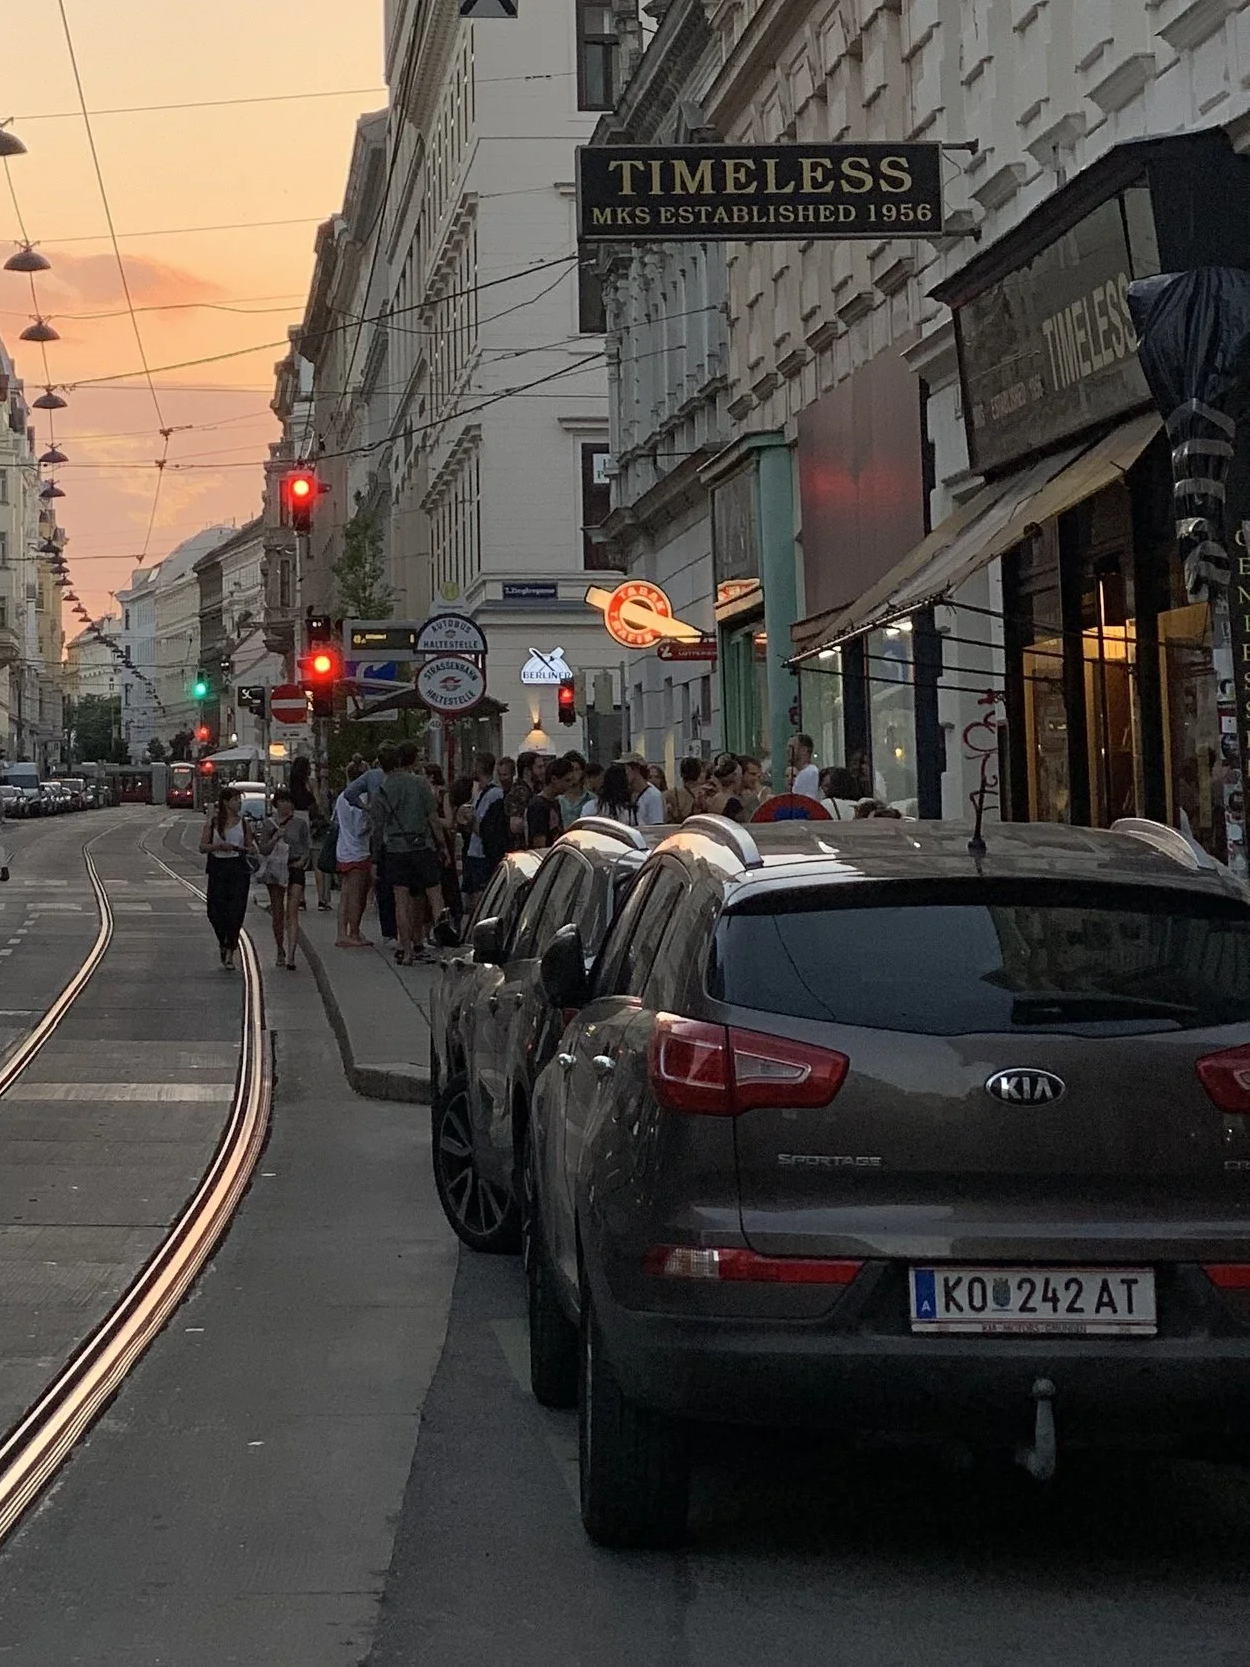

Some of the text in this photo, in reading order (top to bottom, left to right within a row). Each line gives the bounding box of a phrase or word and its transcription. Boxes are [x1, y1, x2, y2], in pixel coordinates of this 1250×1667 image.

[608, 156, 913, 196] TIMELESS
[592, 202, 933, 226] MKS ESTABLISHED 1956
[1042, 271, 1138, 392] TIMELESS
[619, 586, 667, 613] TABAK
[431, 619, 472, 634] AUTOBUS
[609, 610, 655, 644] TRAFIK
[423, 640, 479, 649] HALTESTELLE
[423, 661, 479, 682] STRASSENBAHN
[523, 671, 571, 679] BERLINER
[425, 689, 476, 706] HALTESTELLE
[1000, 1076, 1054, 1100] KIA
[777, 1153, 882, 1167] SPORTAGE
[921, 1300, 932, 1312] A
[943, 1276, 1139, 1314] KO 242 AT
